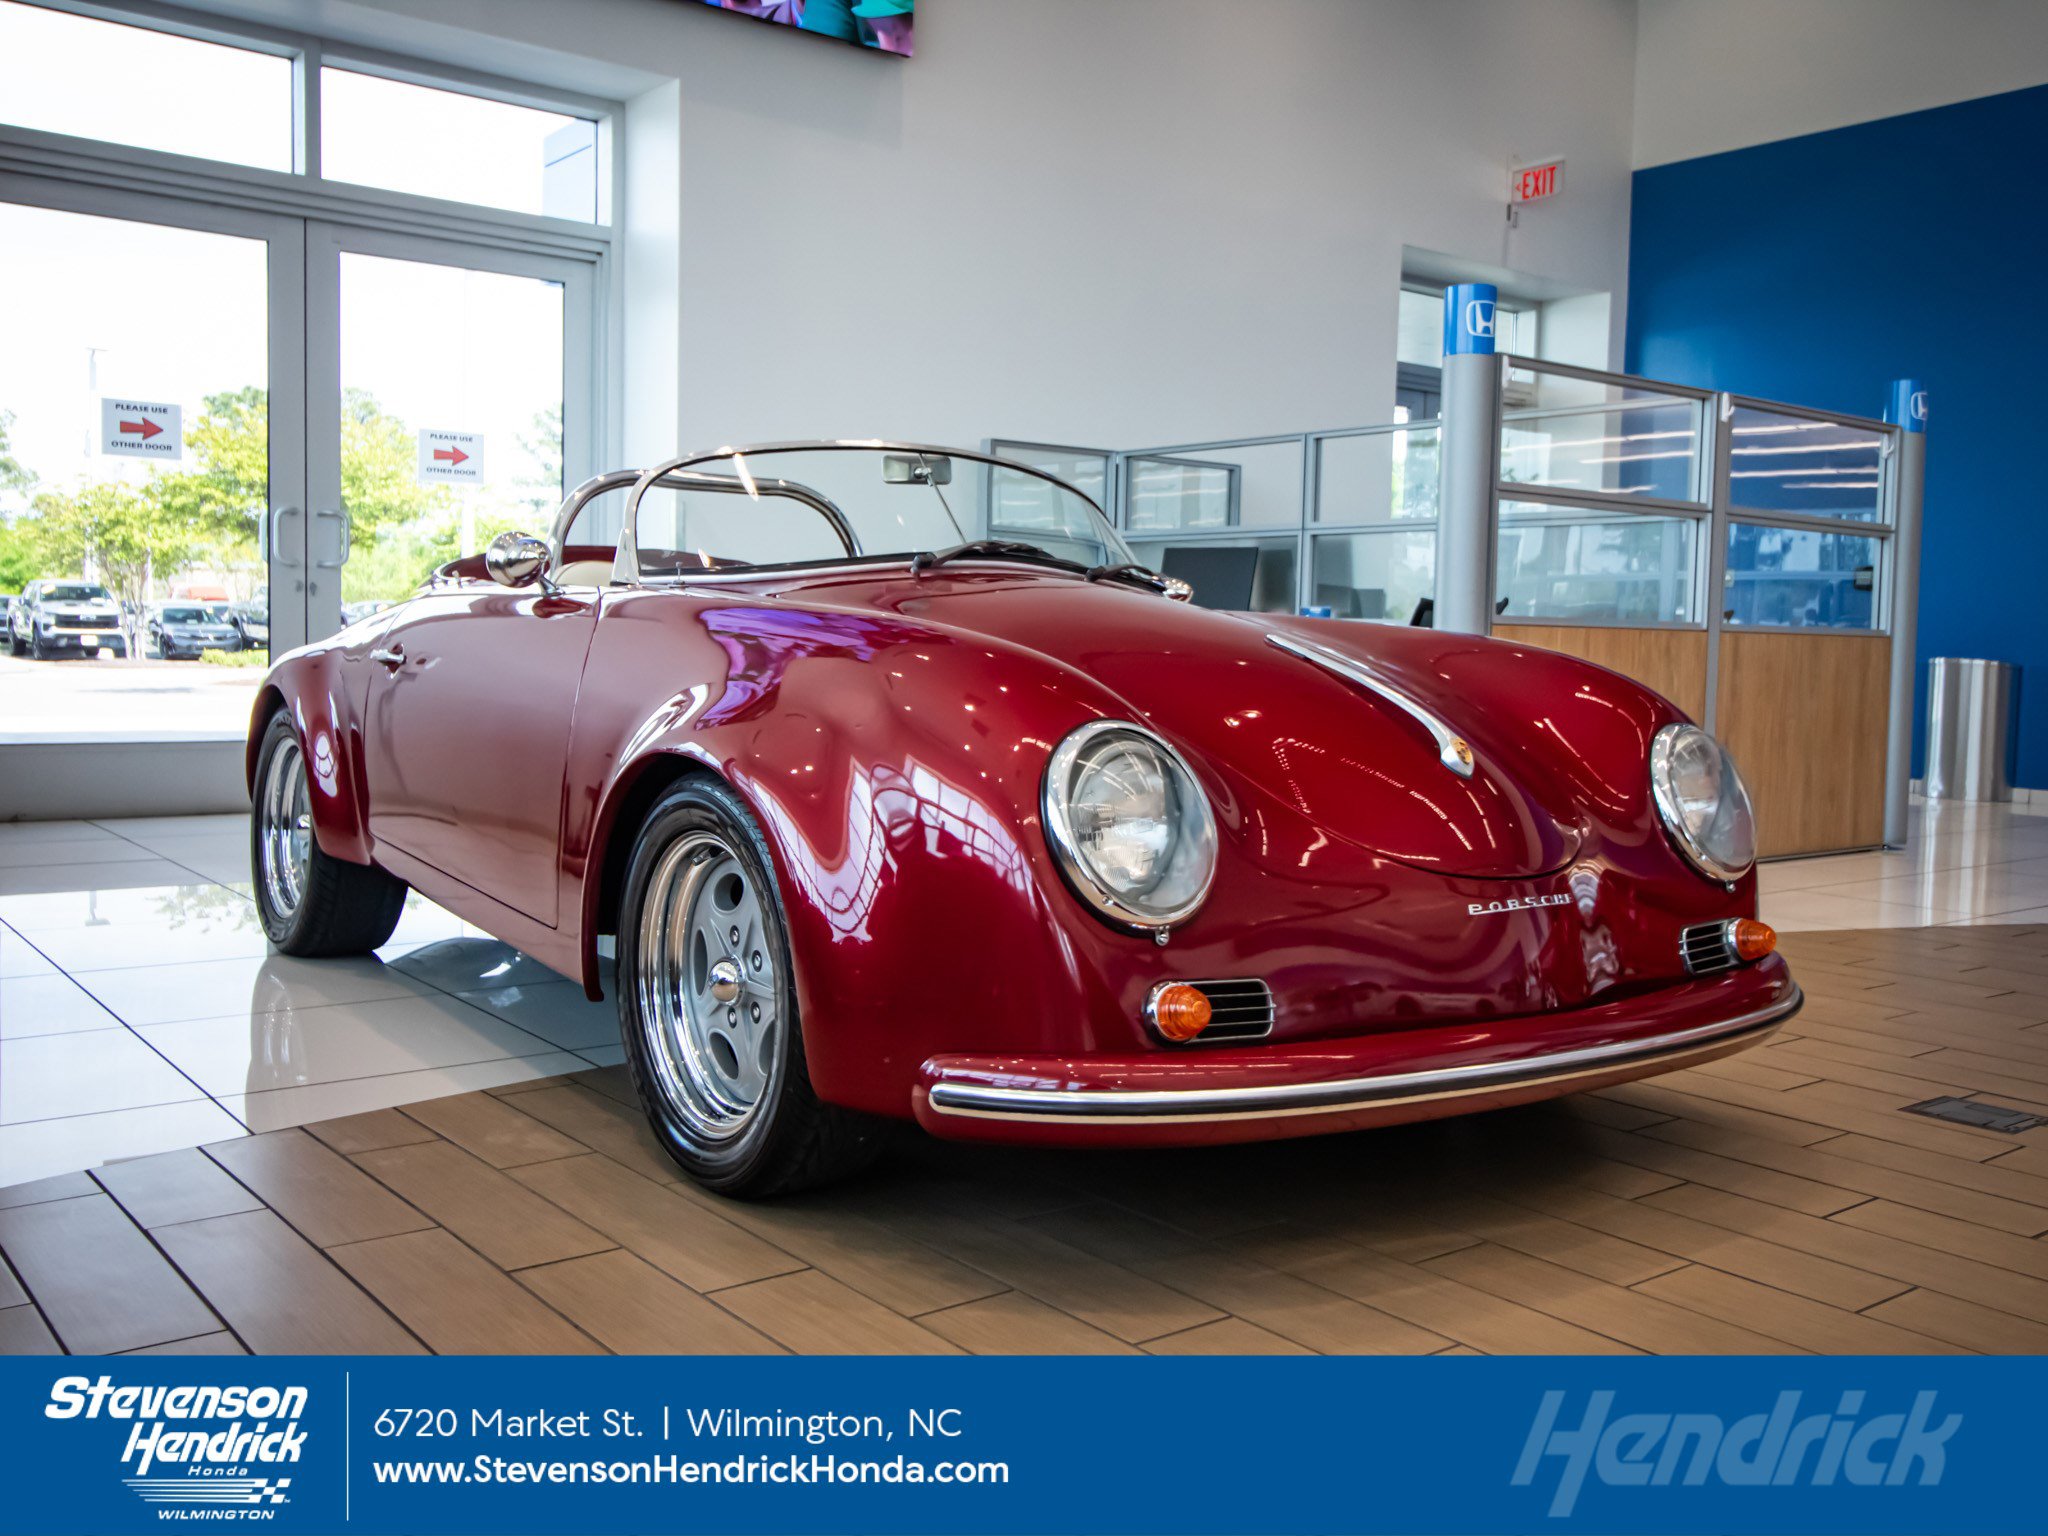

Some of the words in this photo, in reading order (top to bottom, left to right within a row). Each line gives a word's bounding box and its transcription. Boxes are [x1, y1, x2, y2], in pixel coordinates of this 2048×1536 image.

[1522, 166, 1556, 200] EXIT
[115, 403, 149, 412] PLEASE
[430, 433, 457, 441] PLEASE
[111, 440, 142, 449] OTHER
[145, 443, 172, 451] DOOR
